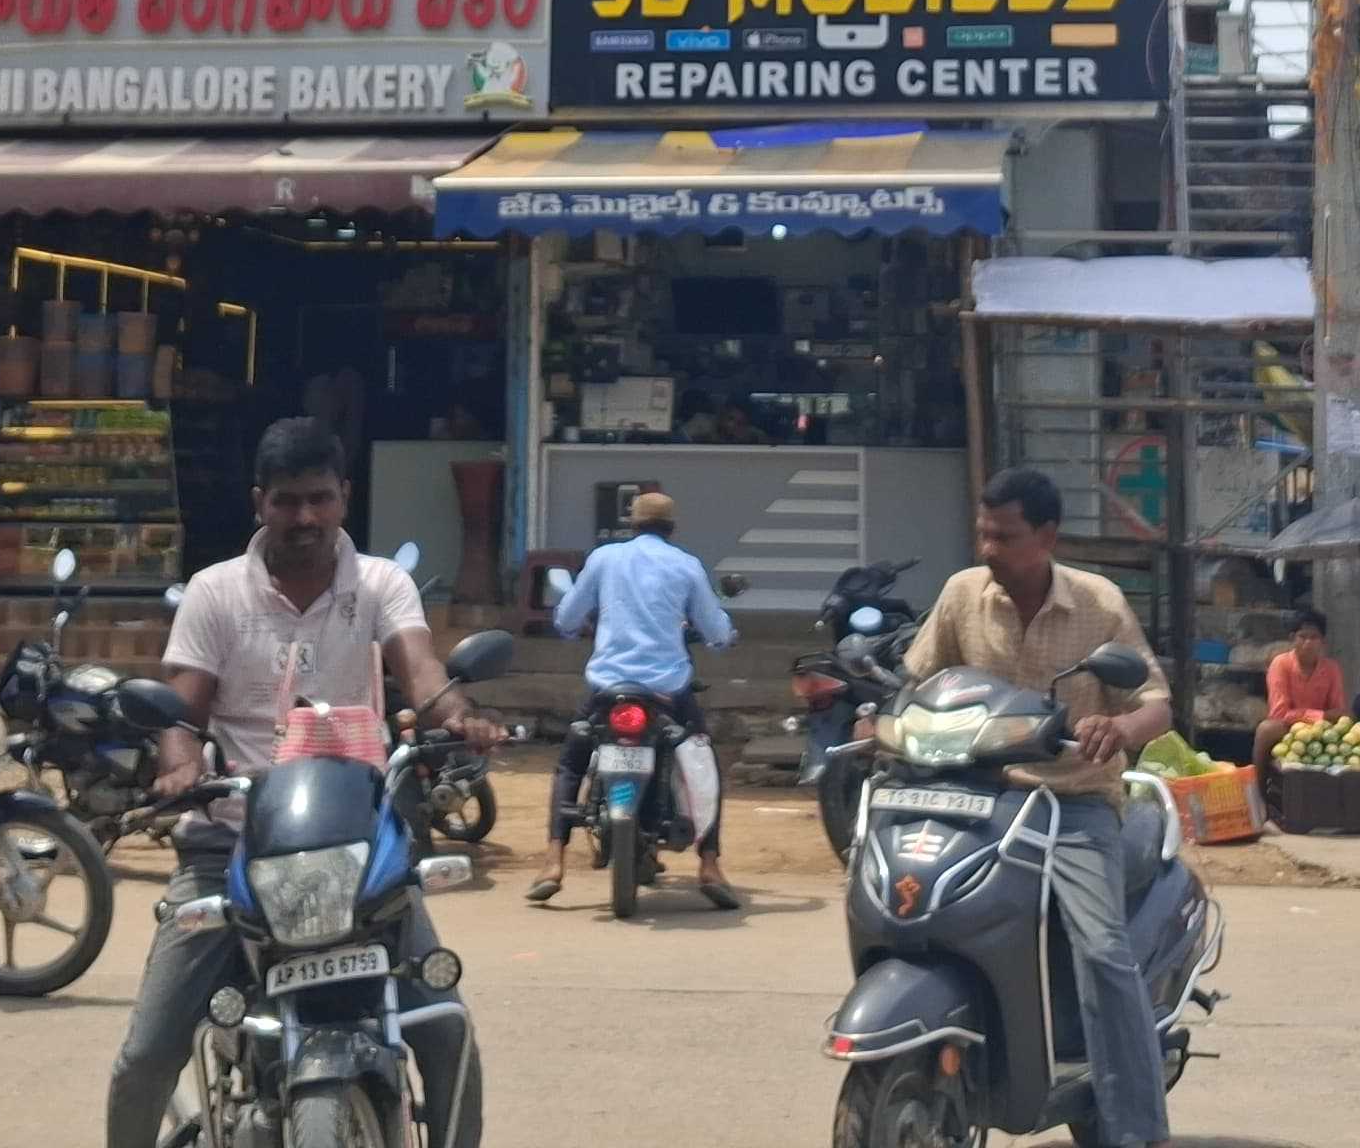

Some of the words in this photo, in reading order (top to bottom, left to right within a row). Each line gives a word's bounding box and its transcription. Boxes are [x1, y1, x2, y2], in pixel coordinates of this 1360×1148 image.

[39, 65, 275, 113] BANGALORE
[289, 63, 453, 111] BAKERY
[615, 60, 876, 99] REPAIRING
[898, 57, 1099, 96] CENTER
